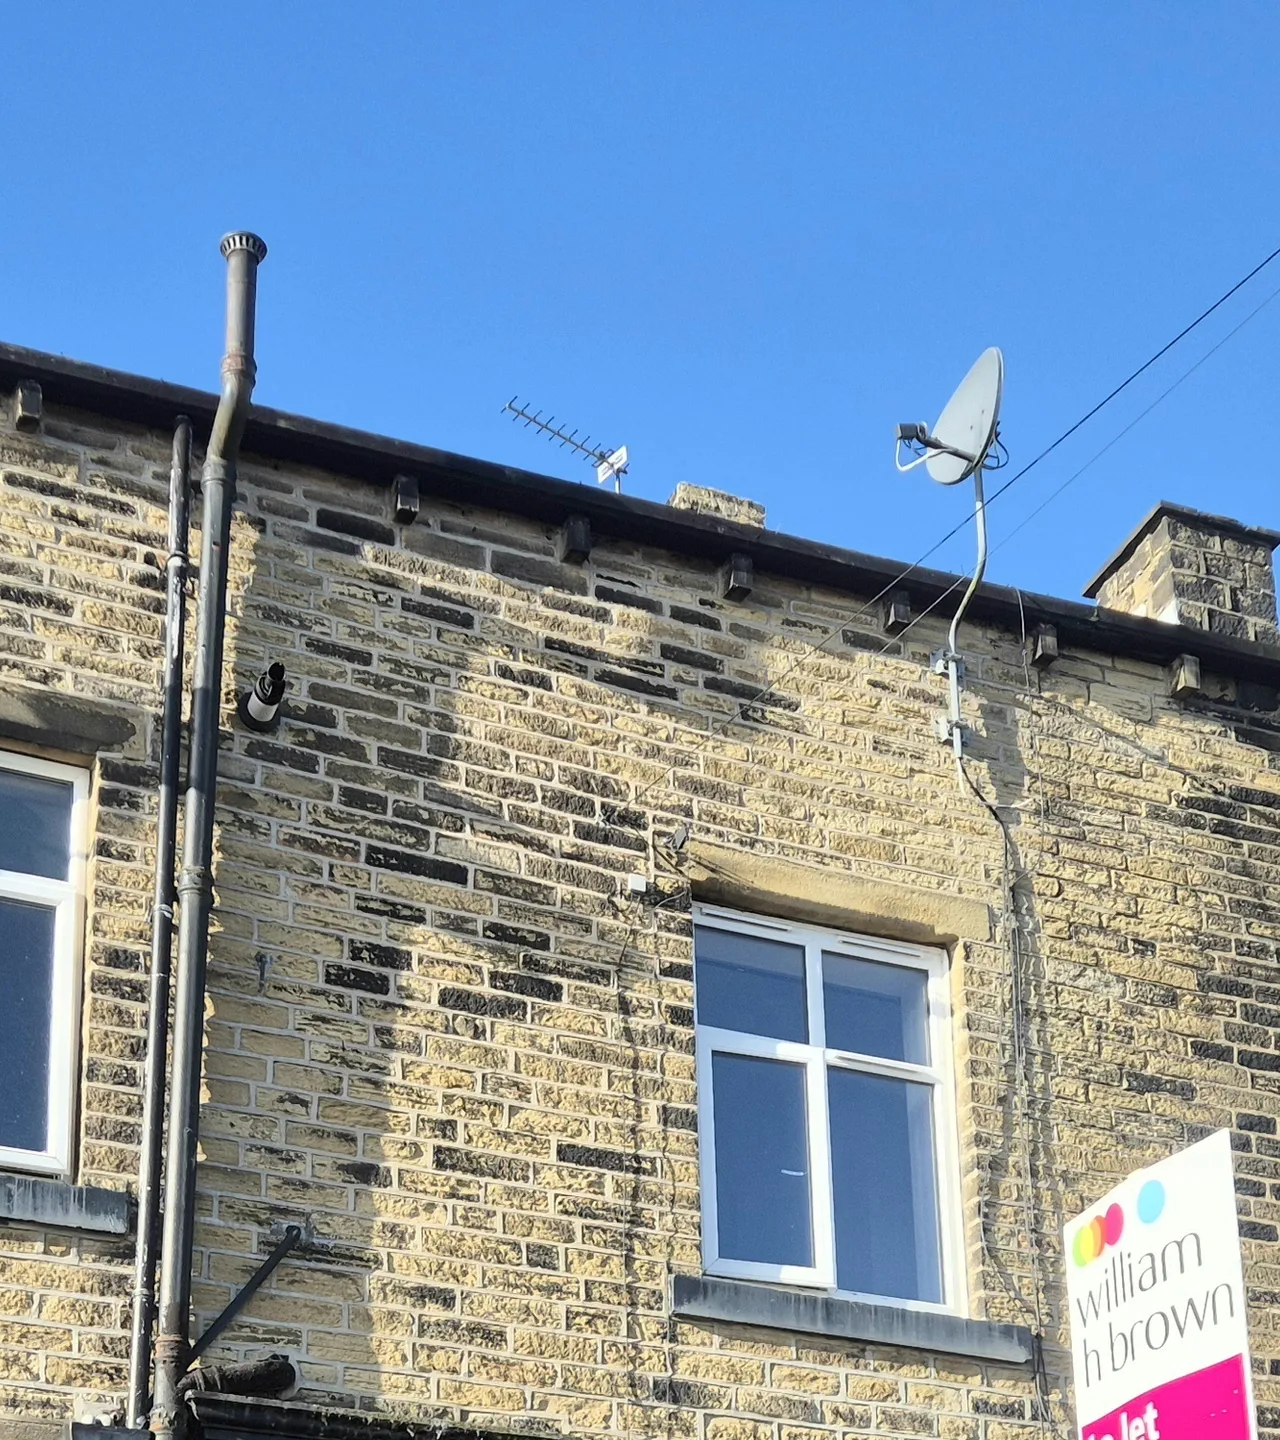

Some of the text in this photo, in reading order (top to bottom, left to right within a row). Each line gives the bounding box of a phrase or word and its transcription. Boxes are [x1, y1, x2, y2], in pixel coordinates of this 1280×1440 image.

[1076, 1232, 1202, 1328] william
[1083, 1283, 1234, 1388] h brown
